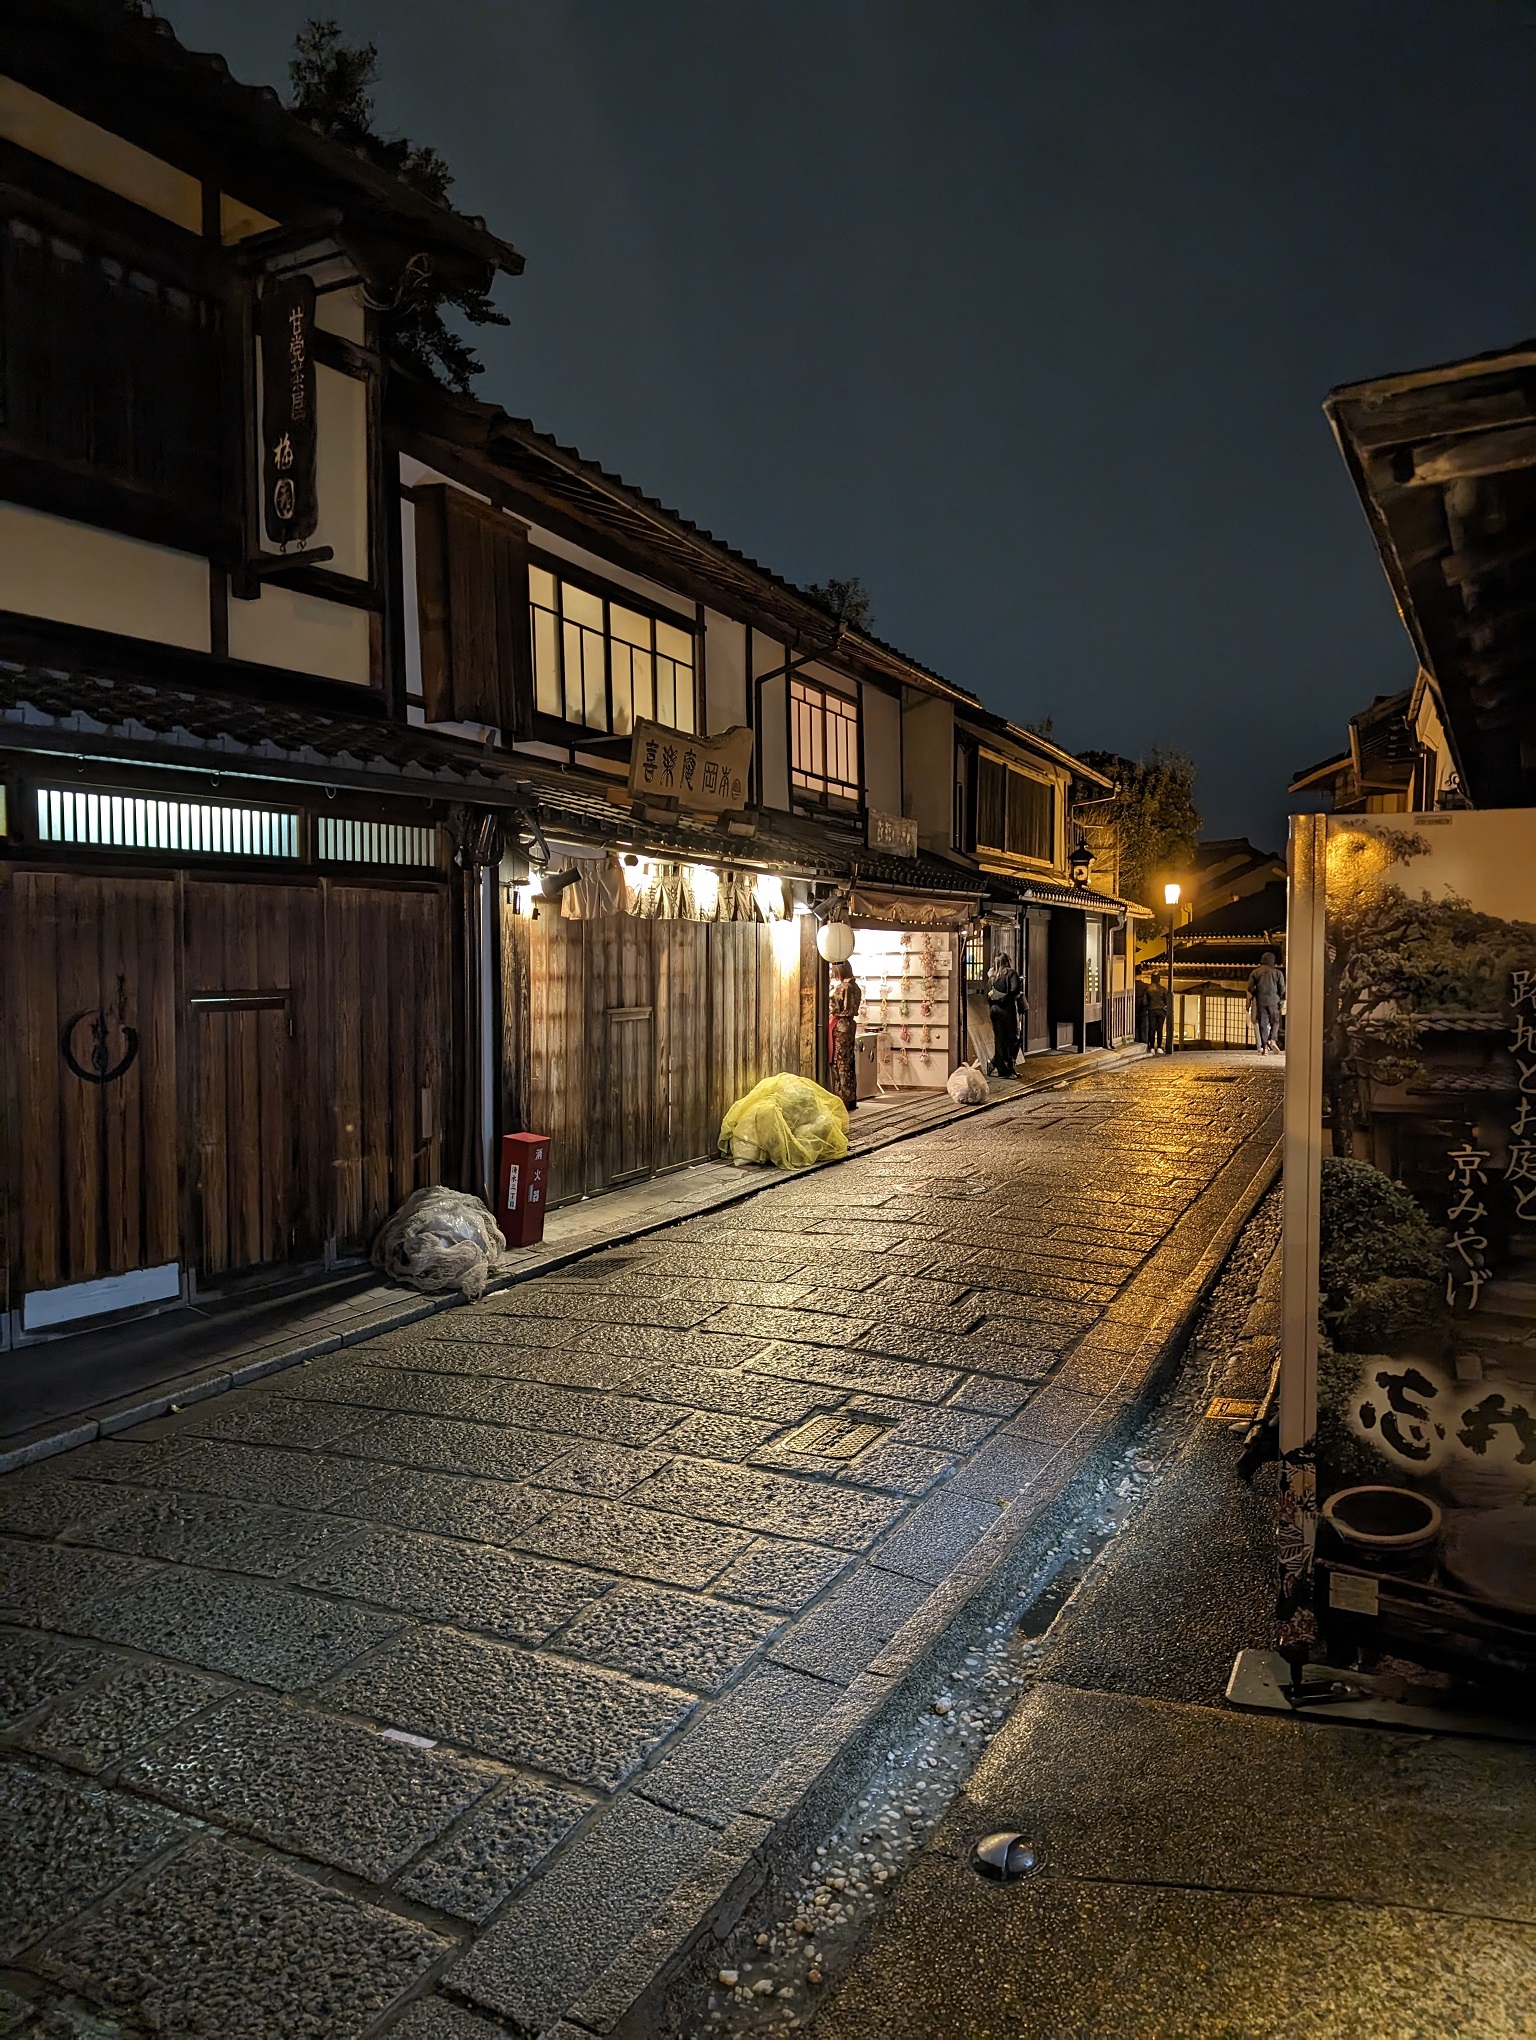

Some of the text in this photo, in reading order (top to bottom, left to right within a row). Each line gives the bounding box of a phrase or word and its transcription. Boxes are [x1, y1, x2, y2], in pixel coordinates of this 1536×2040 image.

[533, 1149, 543, 1202] 消火器
[1445, 1143, 1493, 1311] 京みやげ
